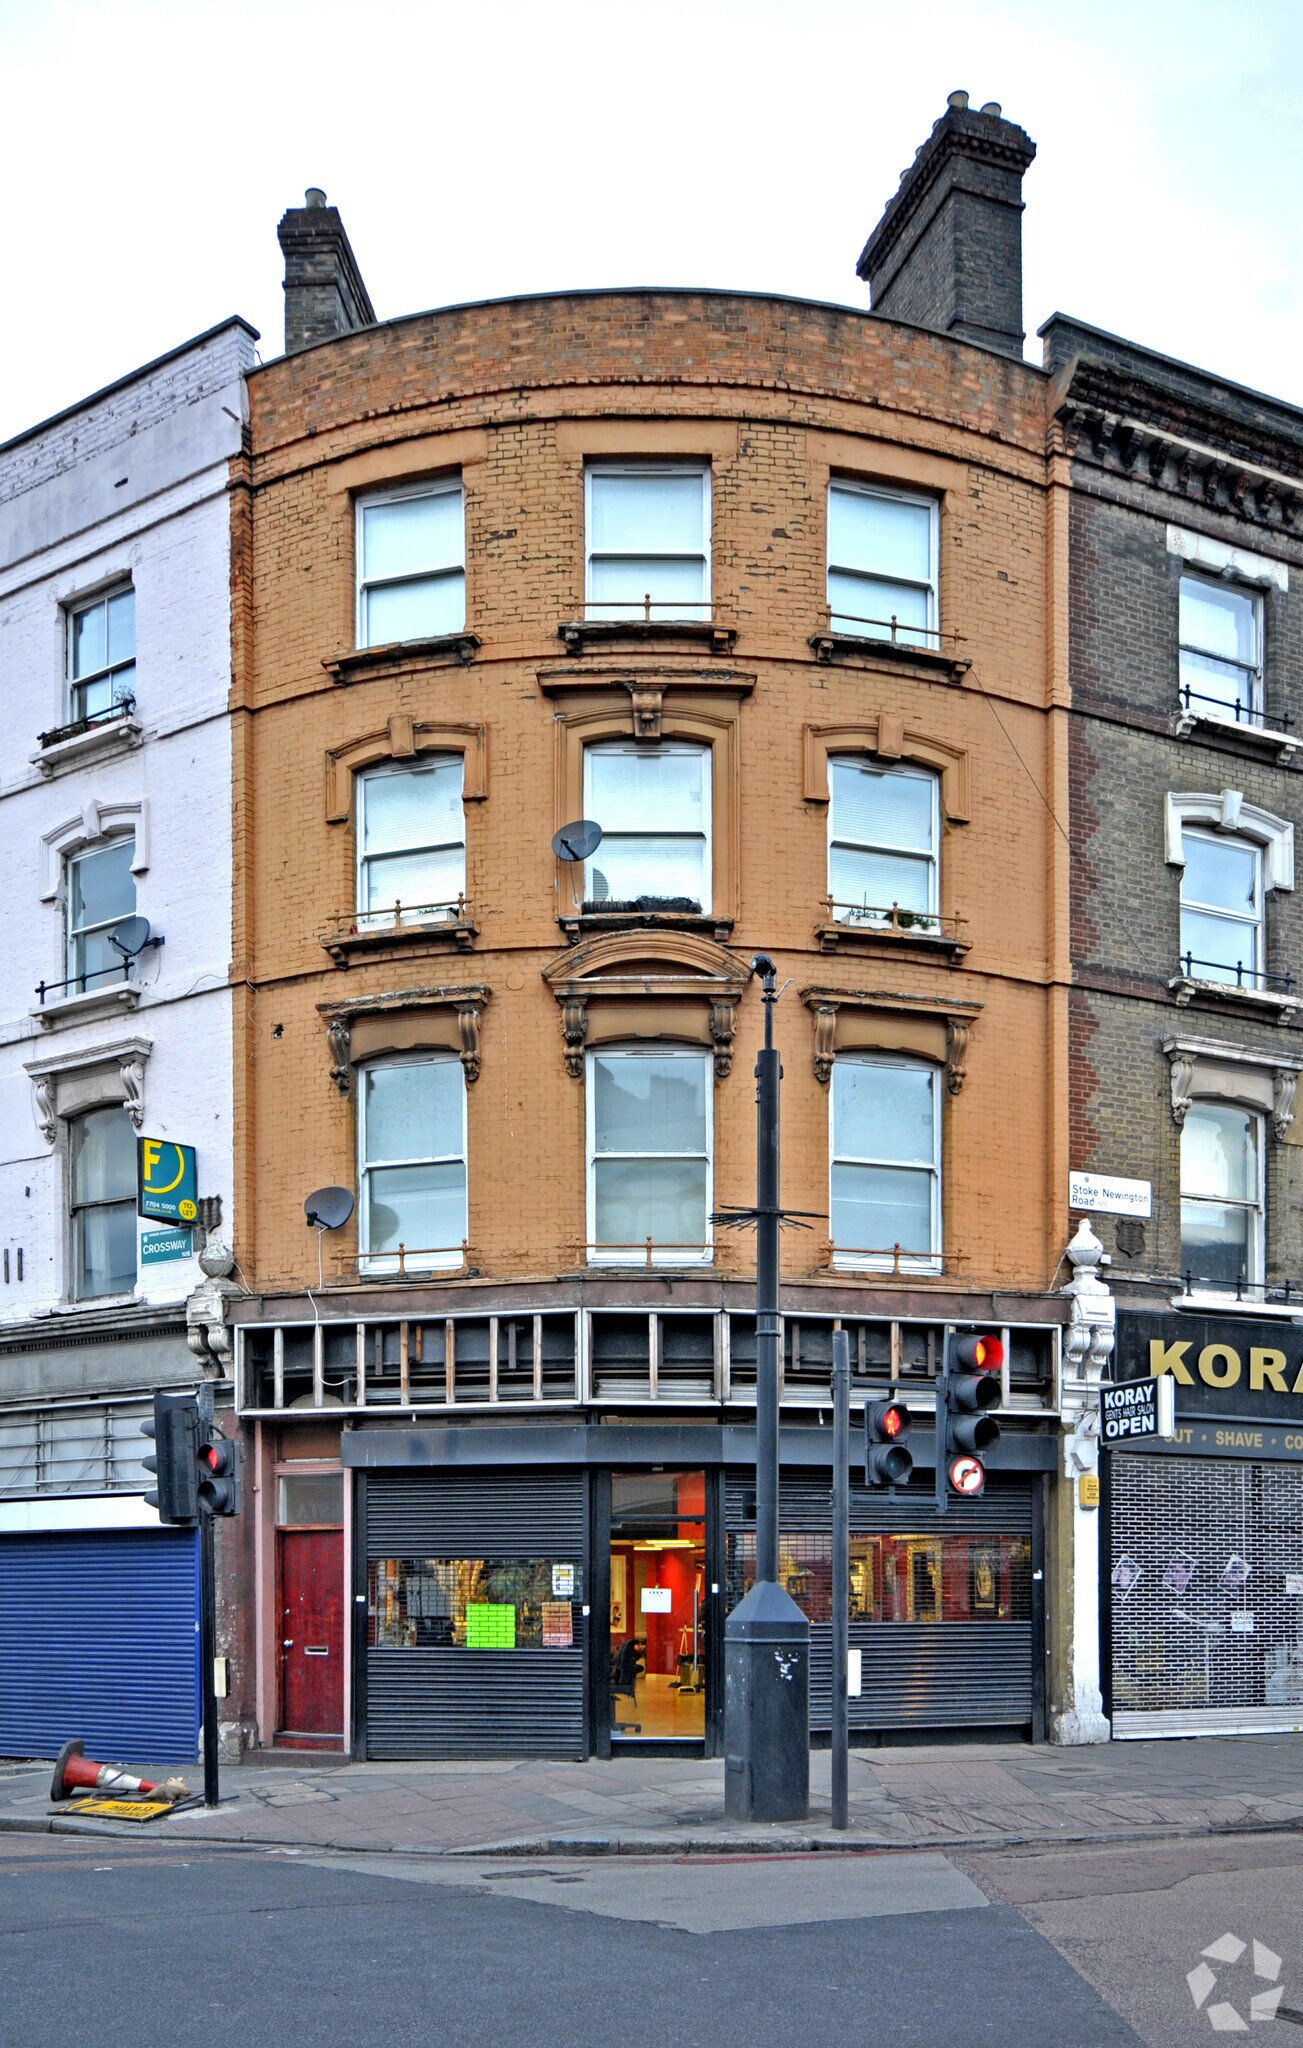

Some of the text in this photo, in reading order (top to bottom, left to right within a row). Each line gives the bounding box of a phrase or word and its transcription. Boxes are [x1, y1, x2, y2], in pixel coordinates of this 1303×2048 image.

[1072, 1184, 1149, 1203] Stoke Newington
[1072, 1194, 1095, 1206] Road
[182, 1209, 194, 1217] LET
[183, 1202, 193, 1210] TO
[143, 1239, 187, 1254] CROSSWAY
[181, 1250, 191, 1258] N16
[1150, 1339, 1303, 1393] KOR
[1104, 1385, 1154, 1409] KORAY
[1122, 1406, 1136, 1418] HAIR
[1137, 1402, 1155, 1416] SALON
[1105, 1414, 1154, 1437] OPEN
[1215, 1430, 1263, 1448] SHAVE
